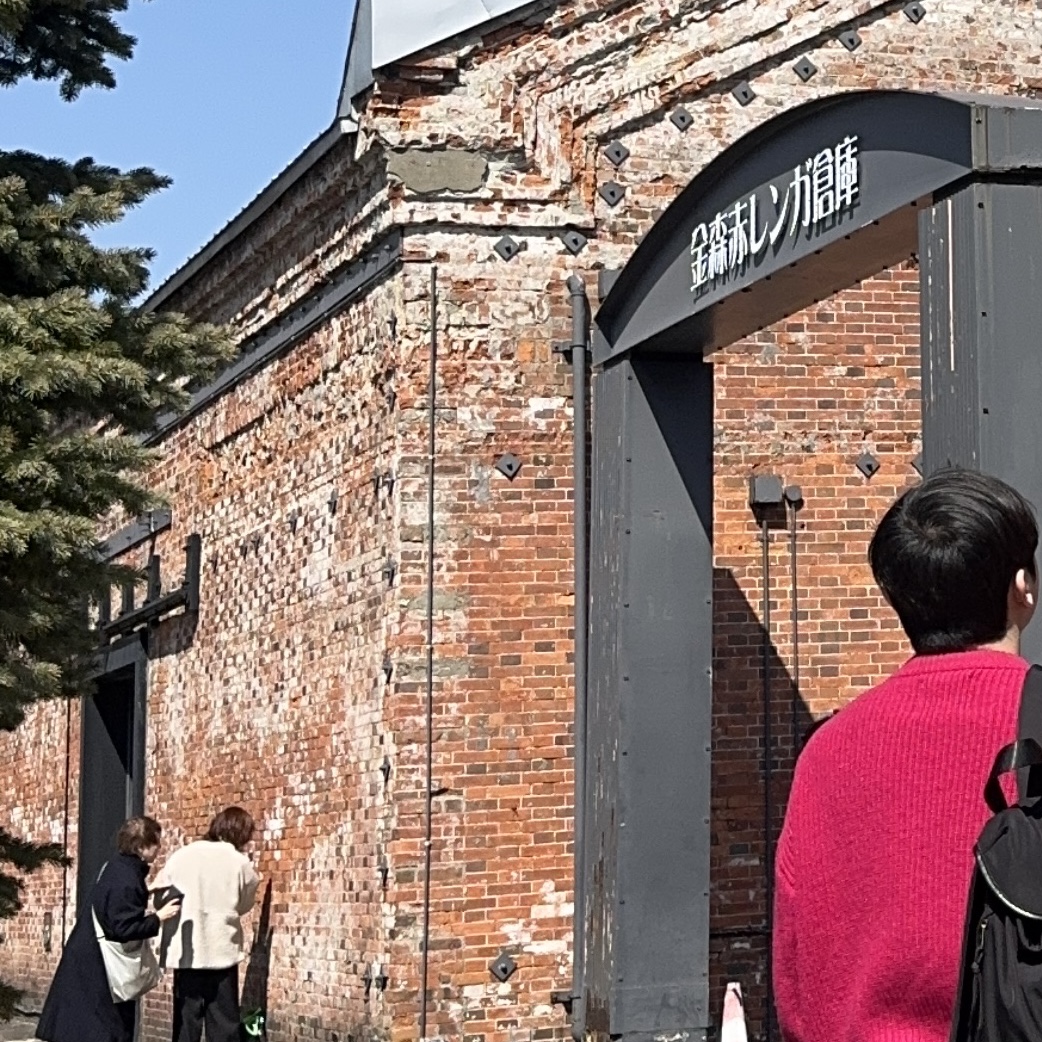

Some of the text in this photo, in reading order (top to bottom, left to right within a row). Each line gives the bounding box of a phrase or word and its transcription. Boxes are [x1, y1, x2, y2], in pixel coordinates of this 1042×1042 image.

[690, 135, 859, 292] 金森赤レンガ倉庫
